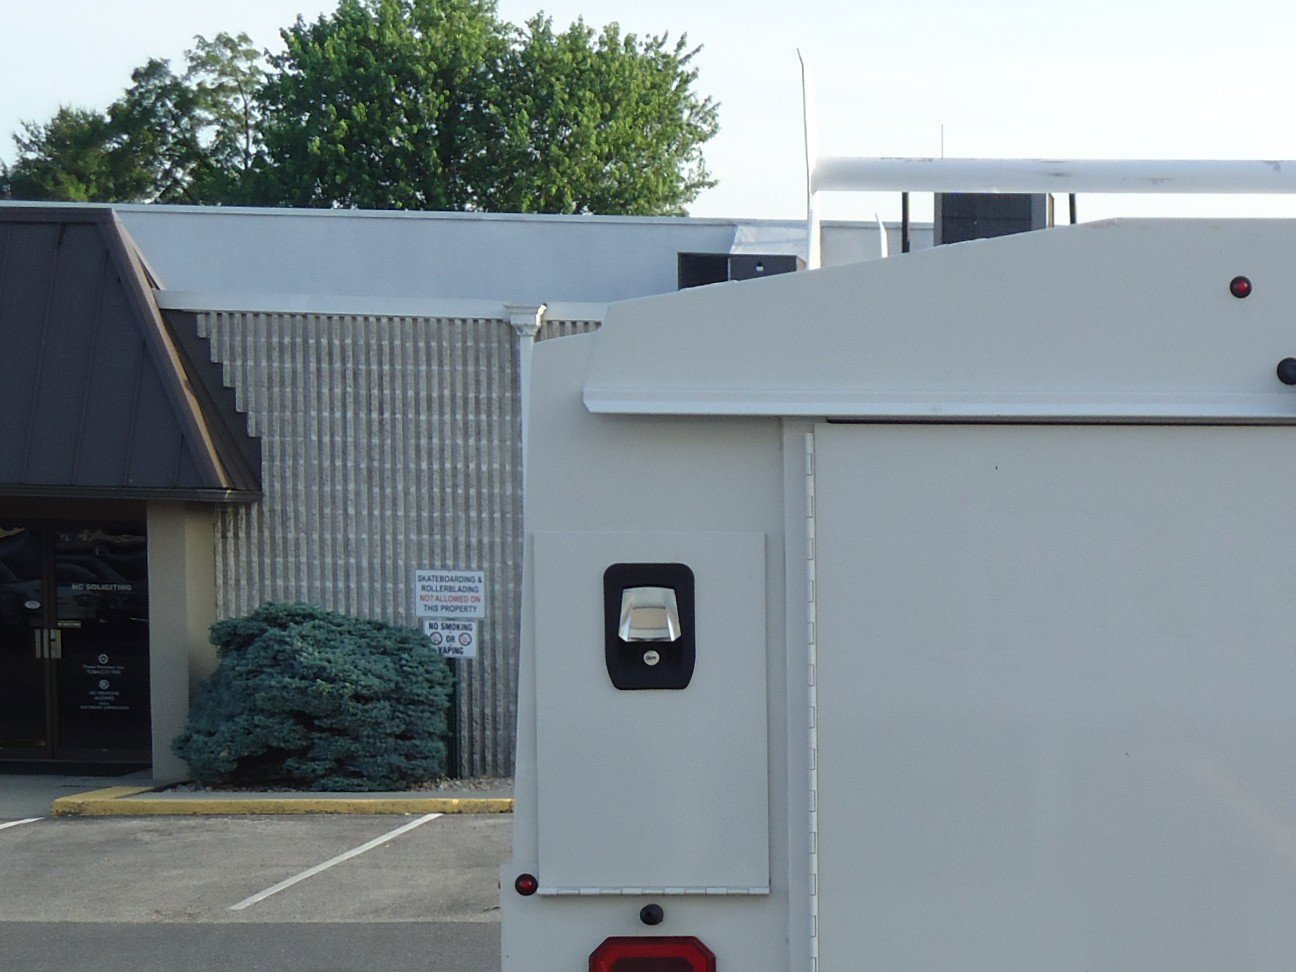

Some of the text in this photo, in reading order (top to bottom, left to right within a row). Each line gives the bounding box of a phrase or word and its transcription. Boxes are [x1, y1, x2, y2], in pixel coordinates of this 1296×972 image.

[417, 575, 476, 583] SKATEBOARDING
[421, 585, 479, 593] ROLLERBLADING
[435, 595, 468, 603] ALLOWED
[423, 604, 477, 613] THIS PROPERTY
[428, 622, 473, 631] NO SMOKING
[445, 635, 456, 643] OR
[437, 646, 464, 655] VAPING
